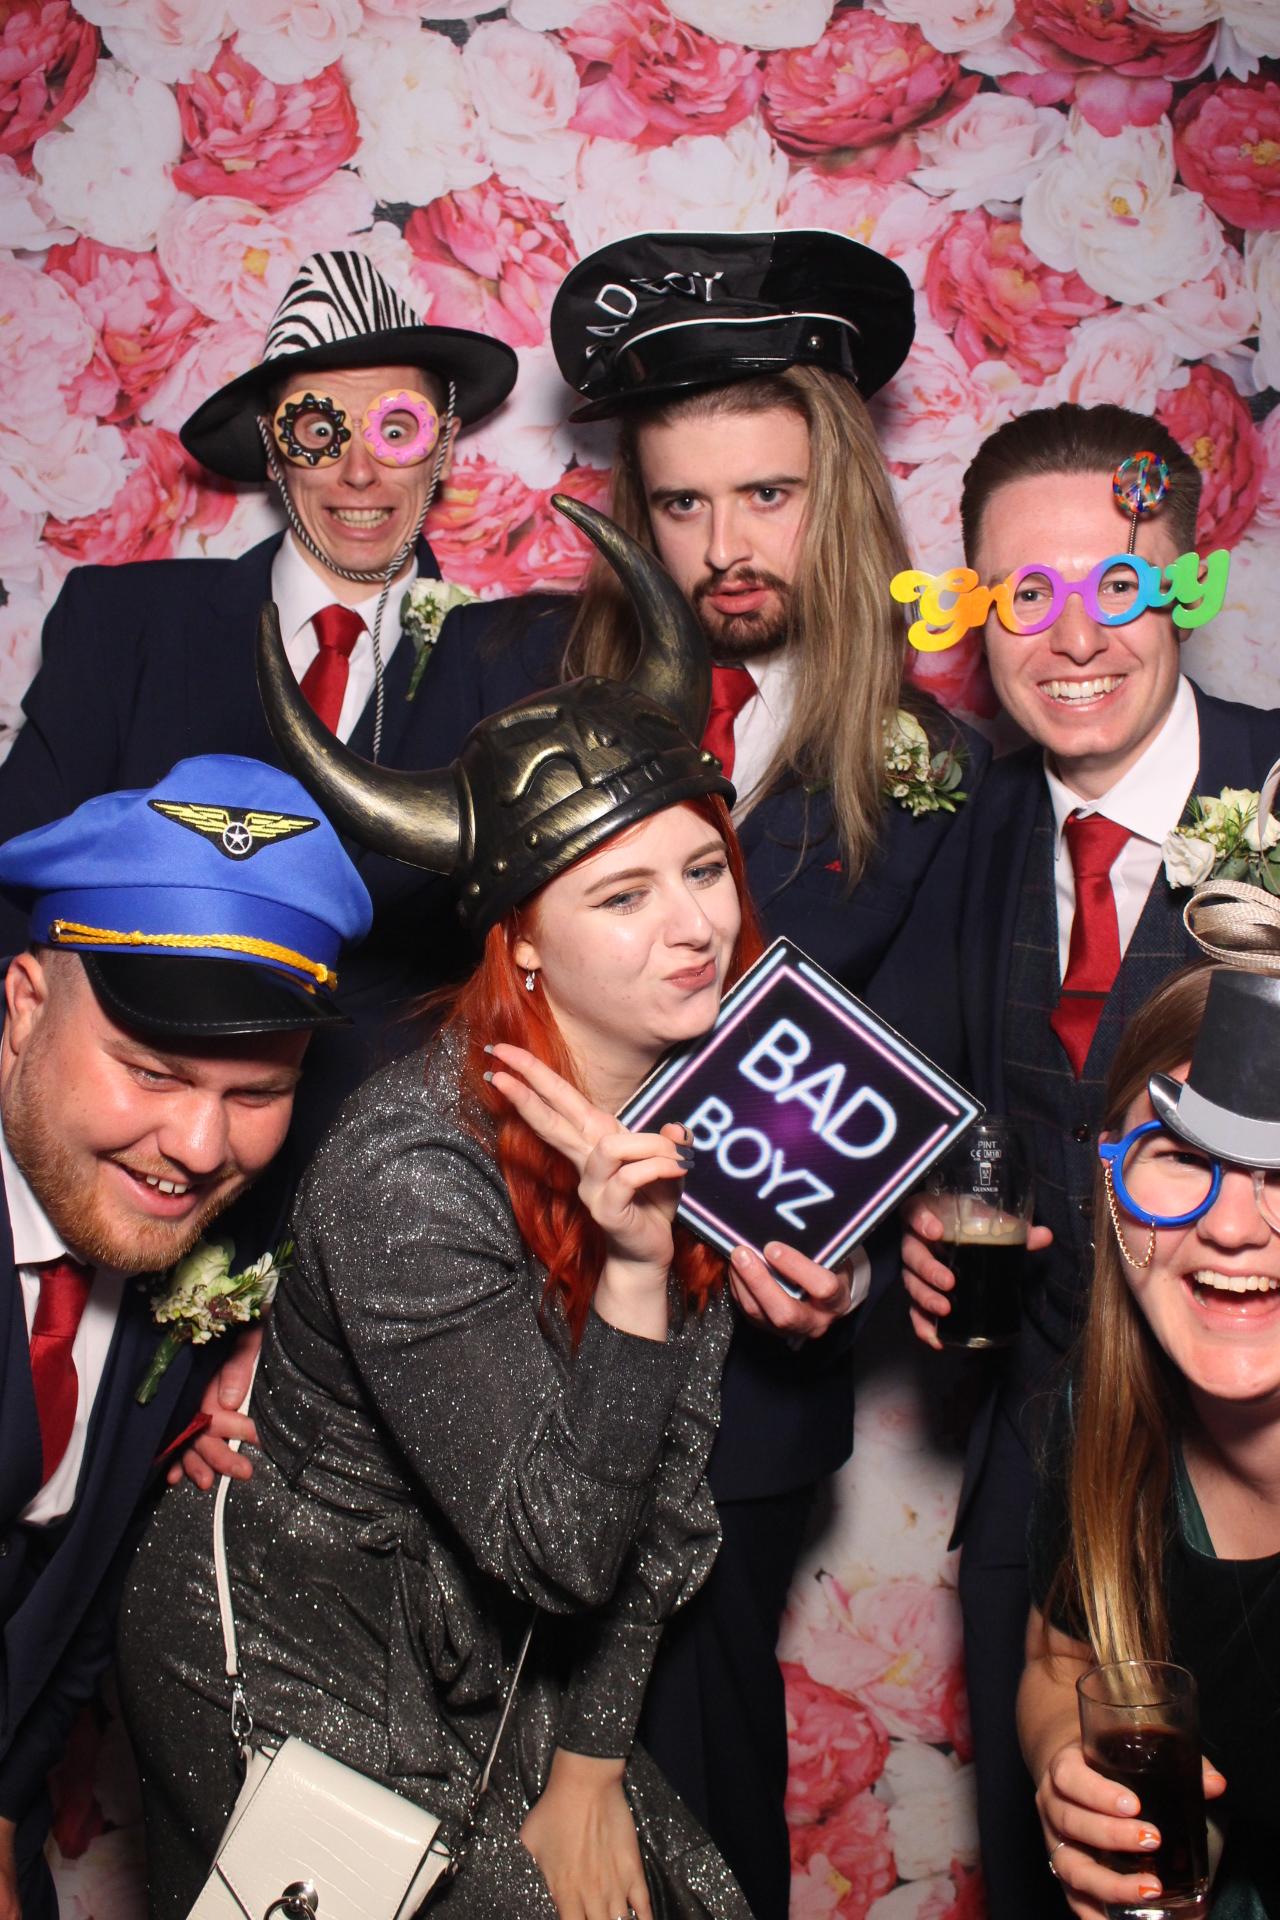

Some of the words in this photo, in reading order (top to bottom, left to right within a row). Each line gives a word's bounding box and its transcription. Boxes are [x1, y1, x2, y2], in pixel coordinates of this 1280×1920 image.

[738, 1018, 898, 1158] BAD
[977, 1140, 997, 1149] PINT
[684, 1096, 834, 1230] BOYZ
